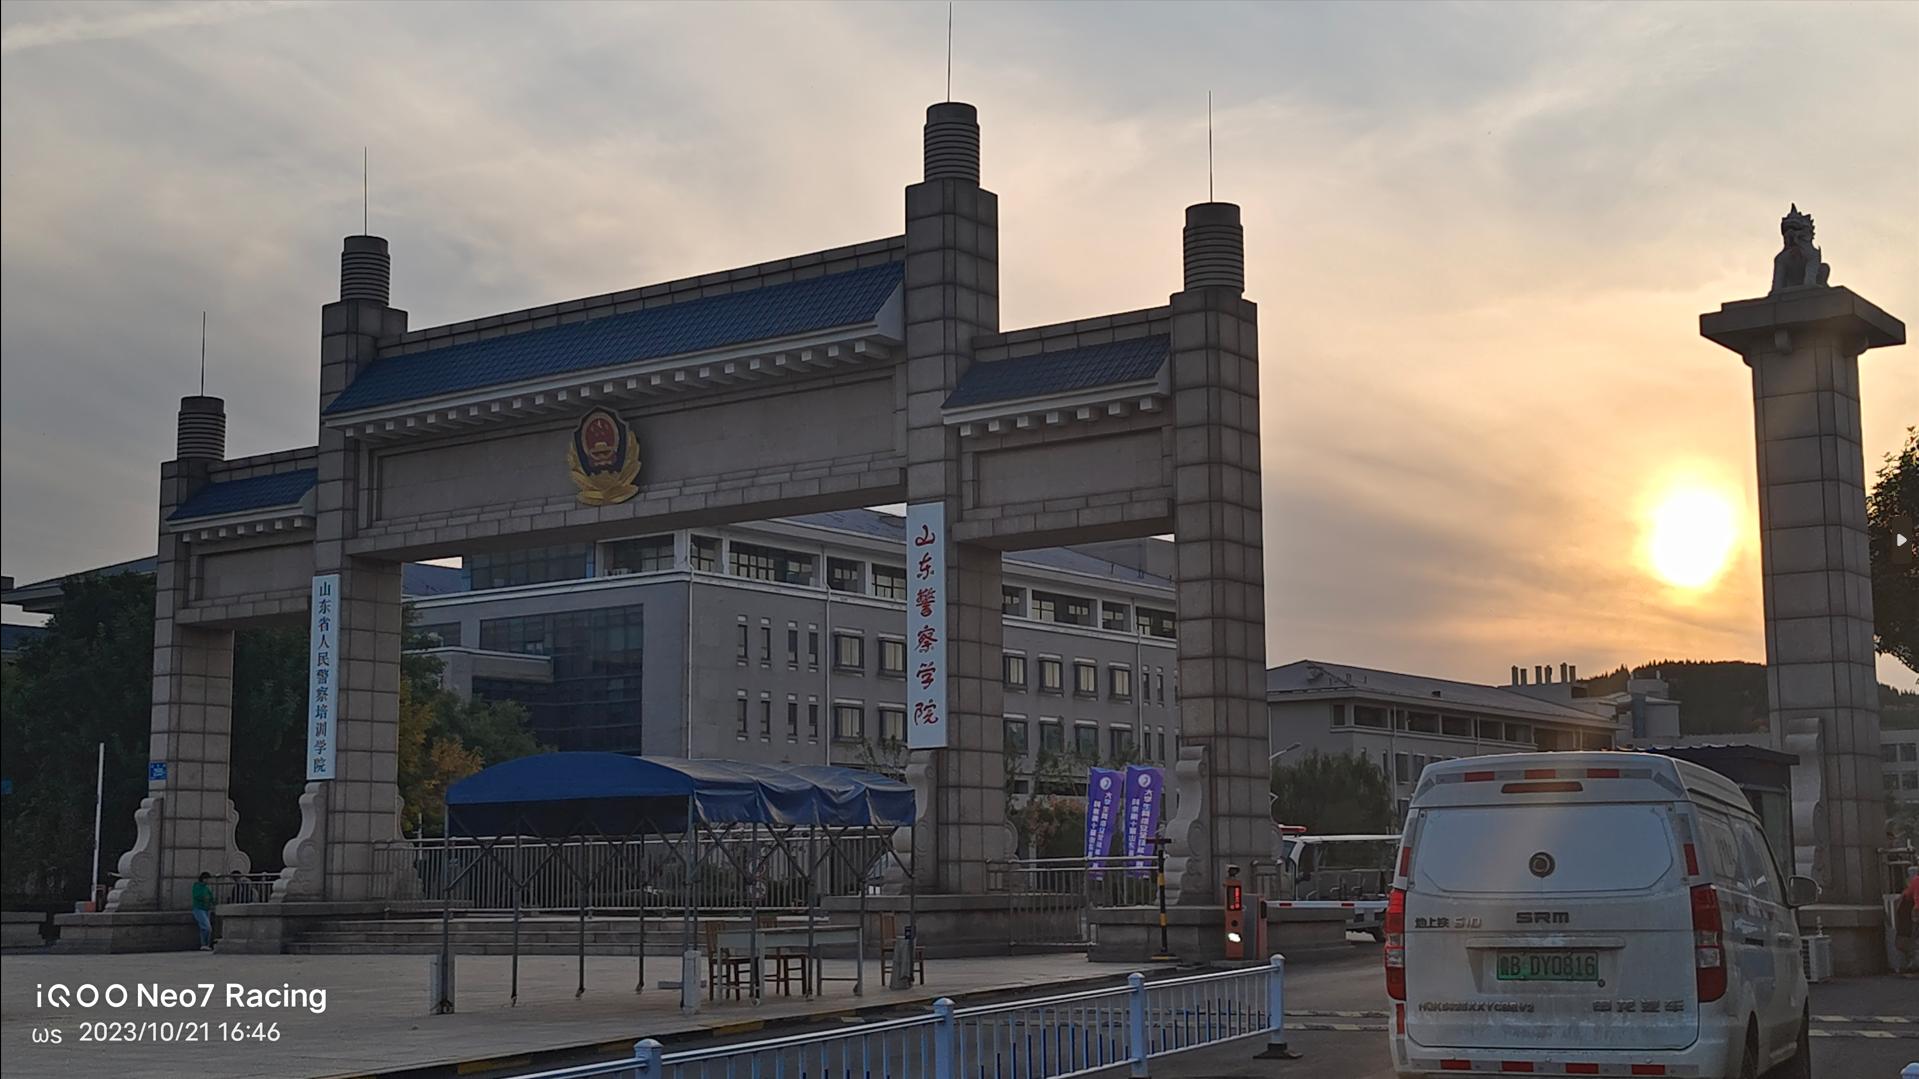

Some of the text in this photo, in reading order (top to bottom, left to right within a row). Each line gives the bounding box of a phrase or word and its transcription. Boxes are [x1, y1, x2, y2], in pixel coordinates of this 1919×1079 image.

[313, 581, 331, 774] 山东省人民警察培训学院
[914, 524, 939, 726] 山东警察学院
[1516, 912, 1569, 923] SRM
